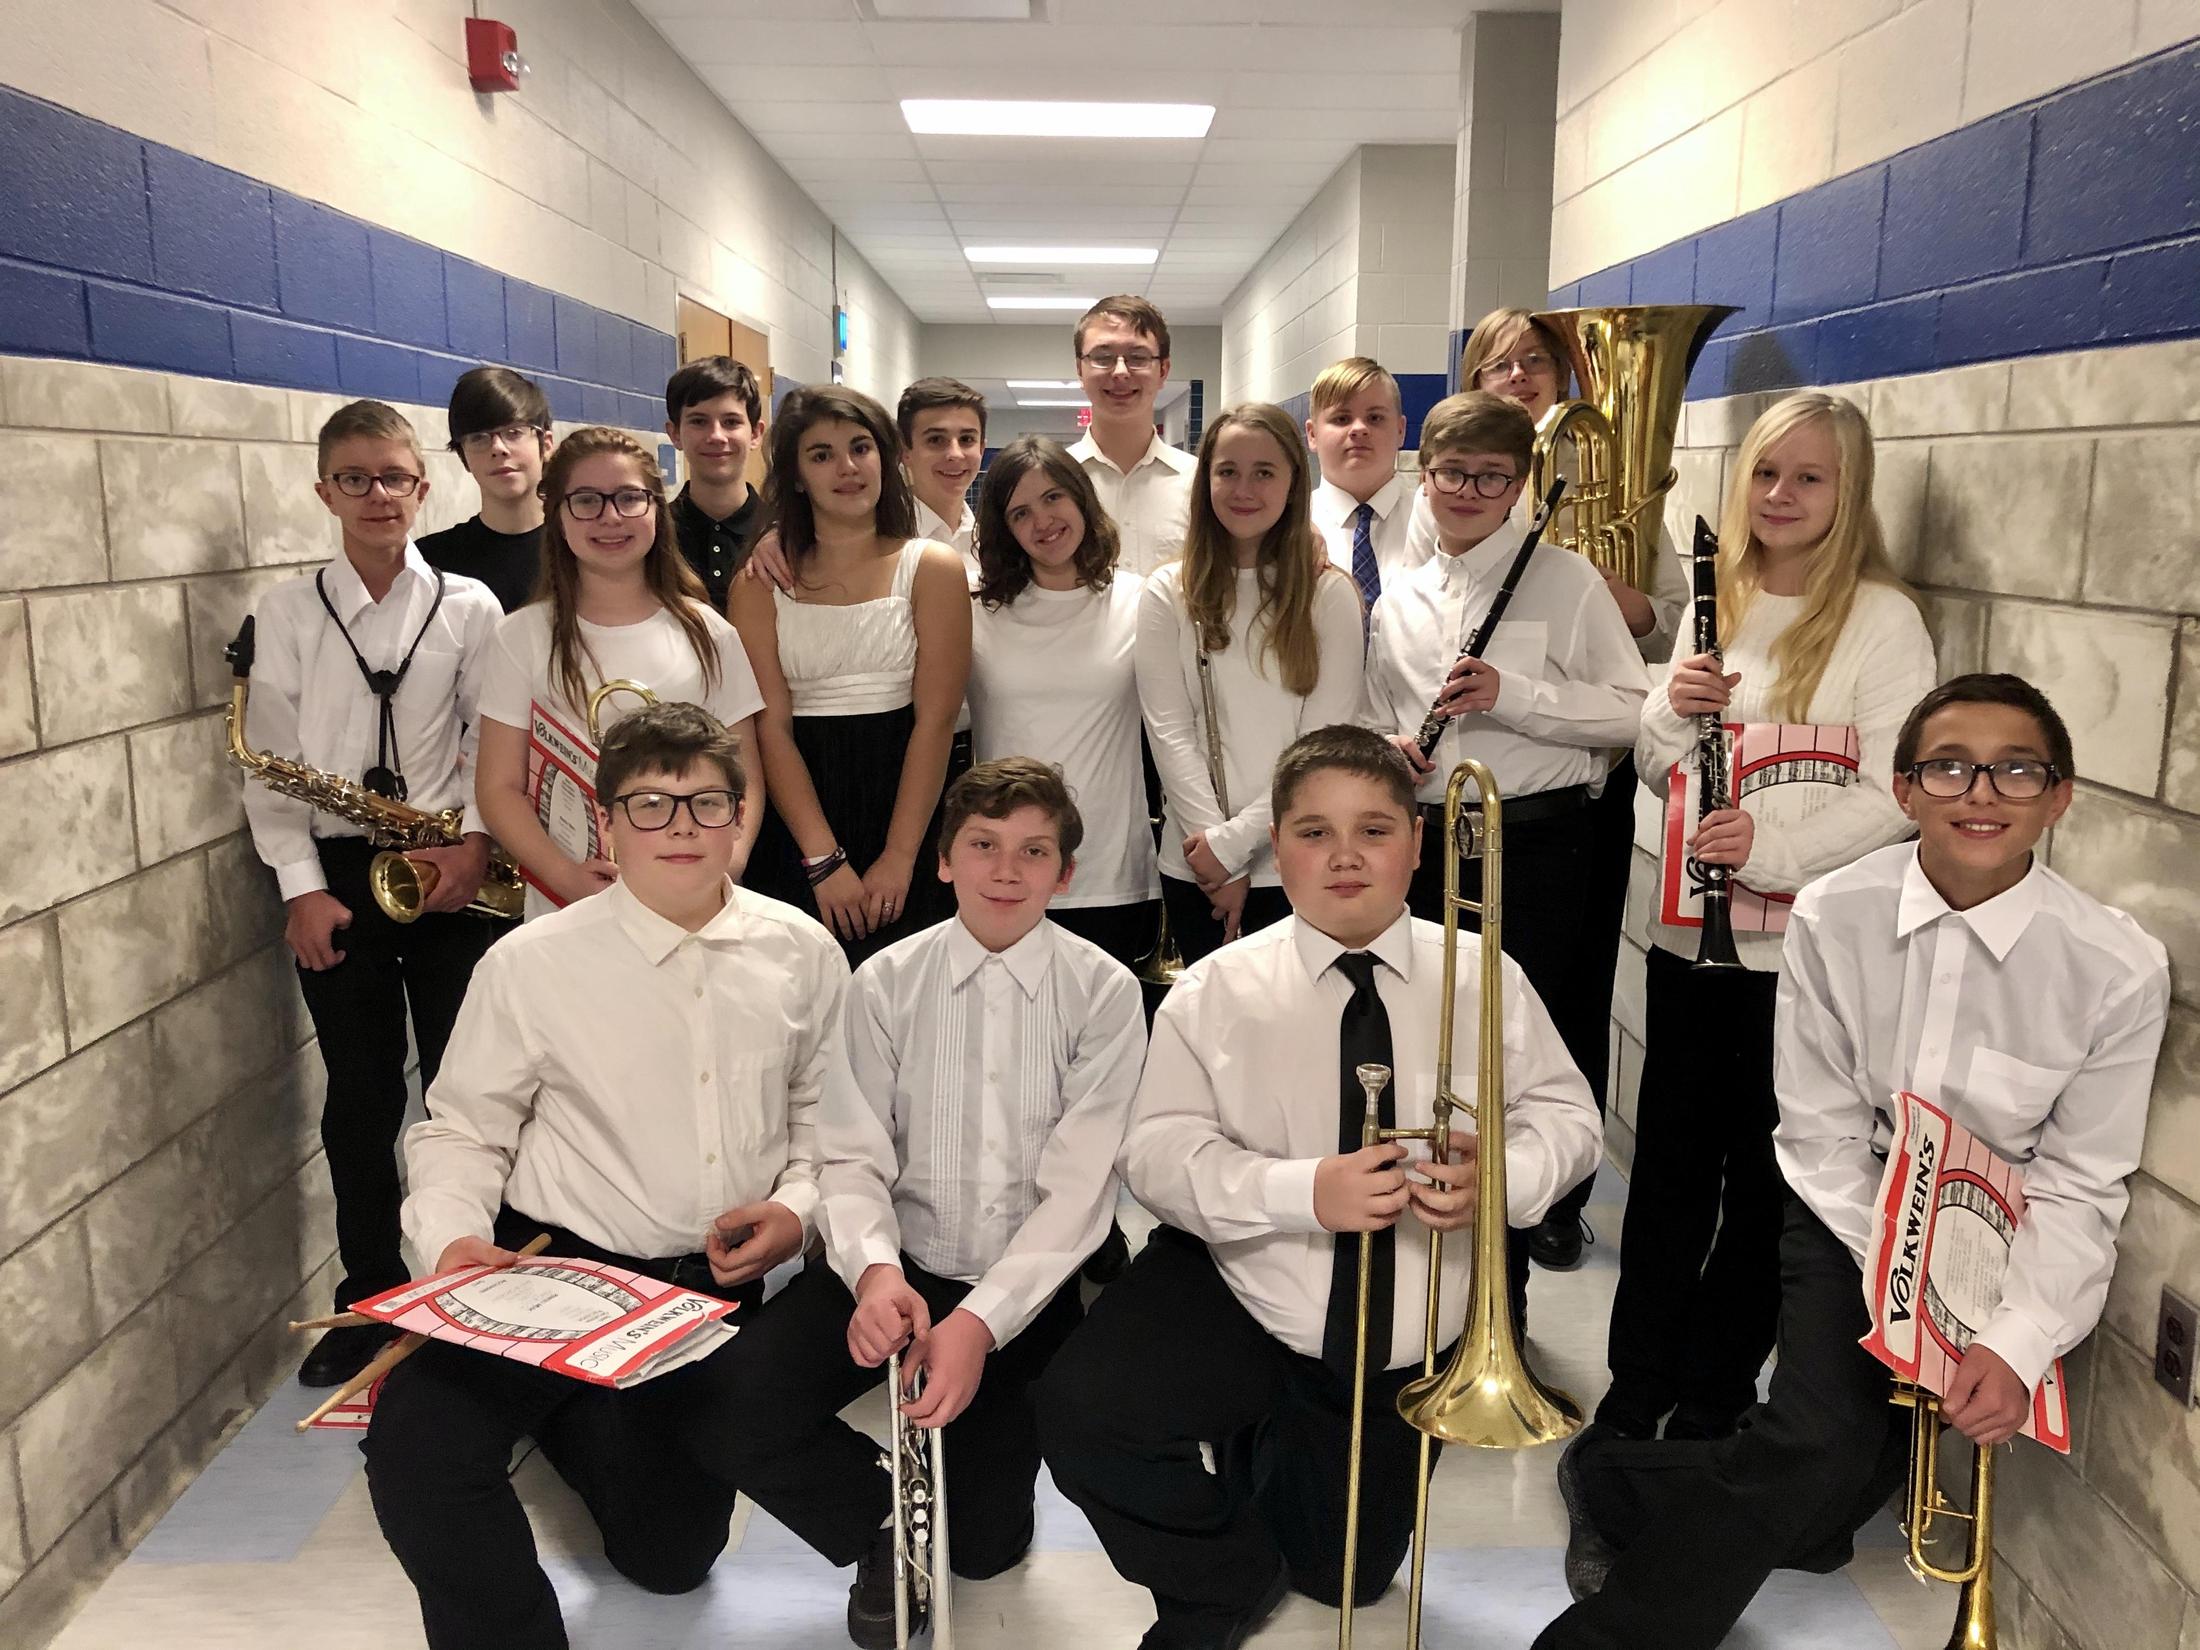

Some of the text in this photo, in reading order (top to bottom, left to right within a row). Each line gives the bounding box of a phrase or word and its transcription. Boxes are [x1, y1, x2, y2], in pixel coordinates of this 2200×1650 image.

[1890, 1132, 1935, 1324] VOLKWEIN'S
[626, 1298, 710, 1339] VOLKWEIN'S
[580, 1338, 637, 1368] MUSIC
